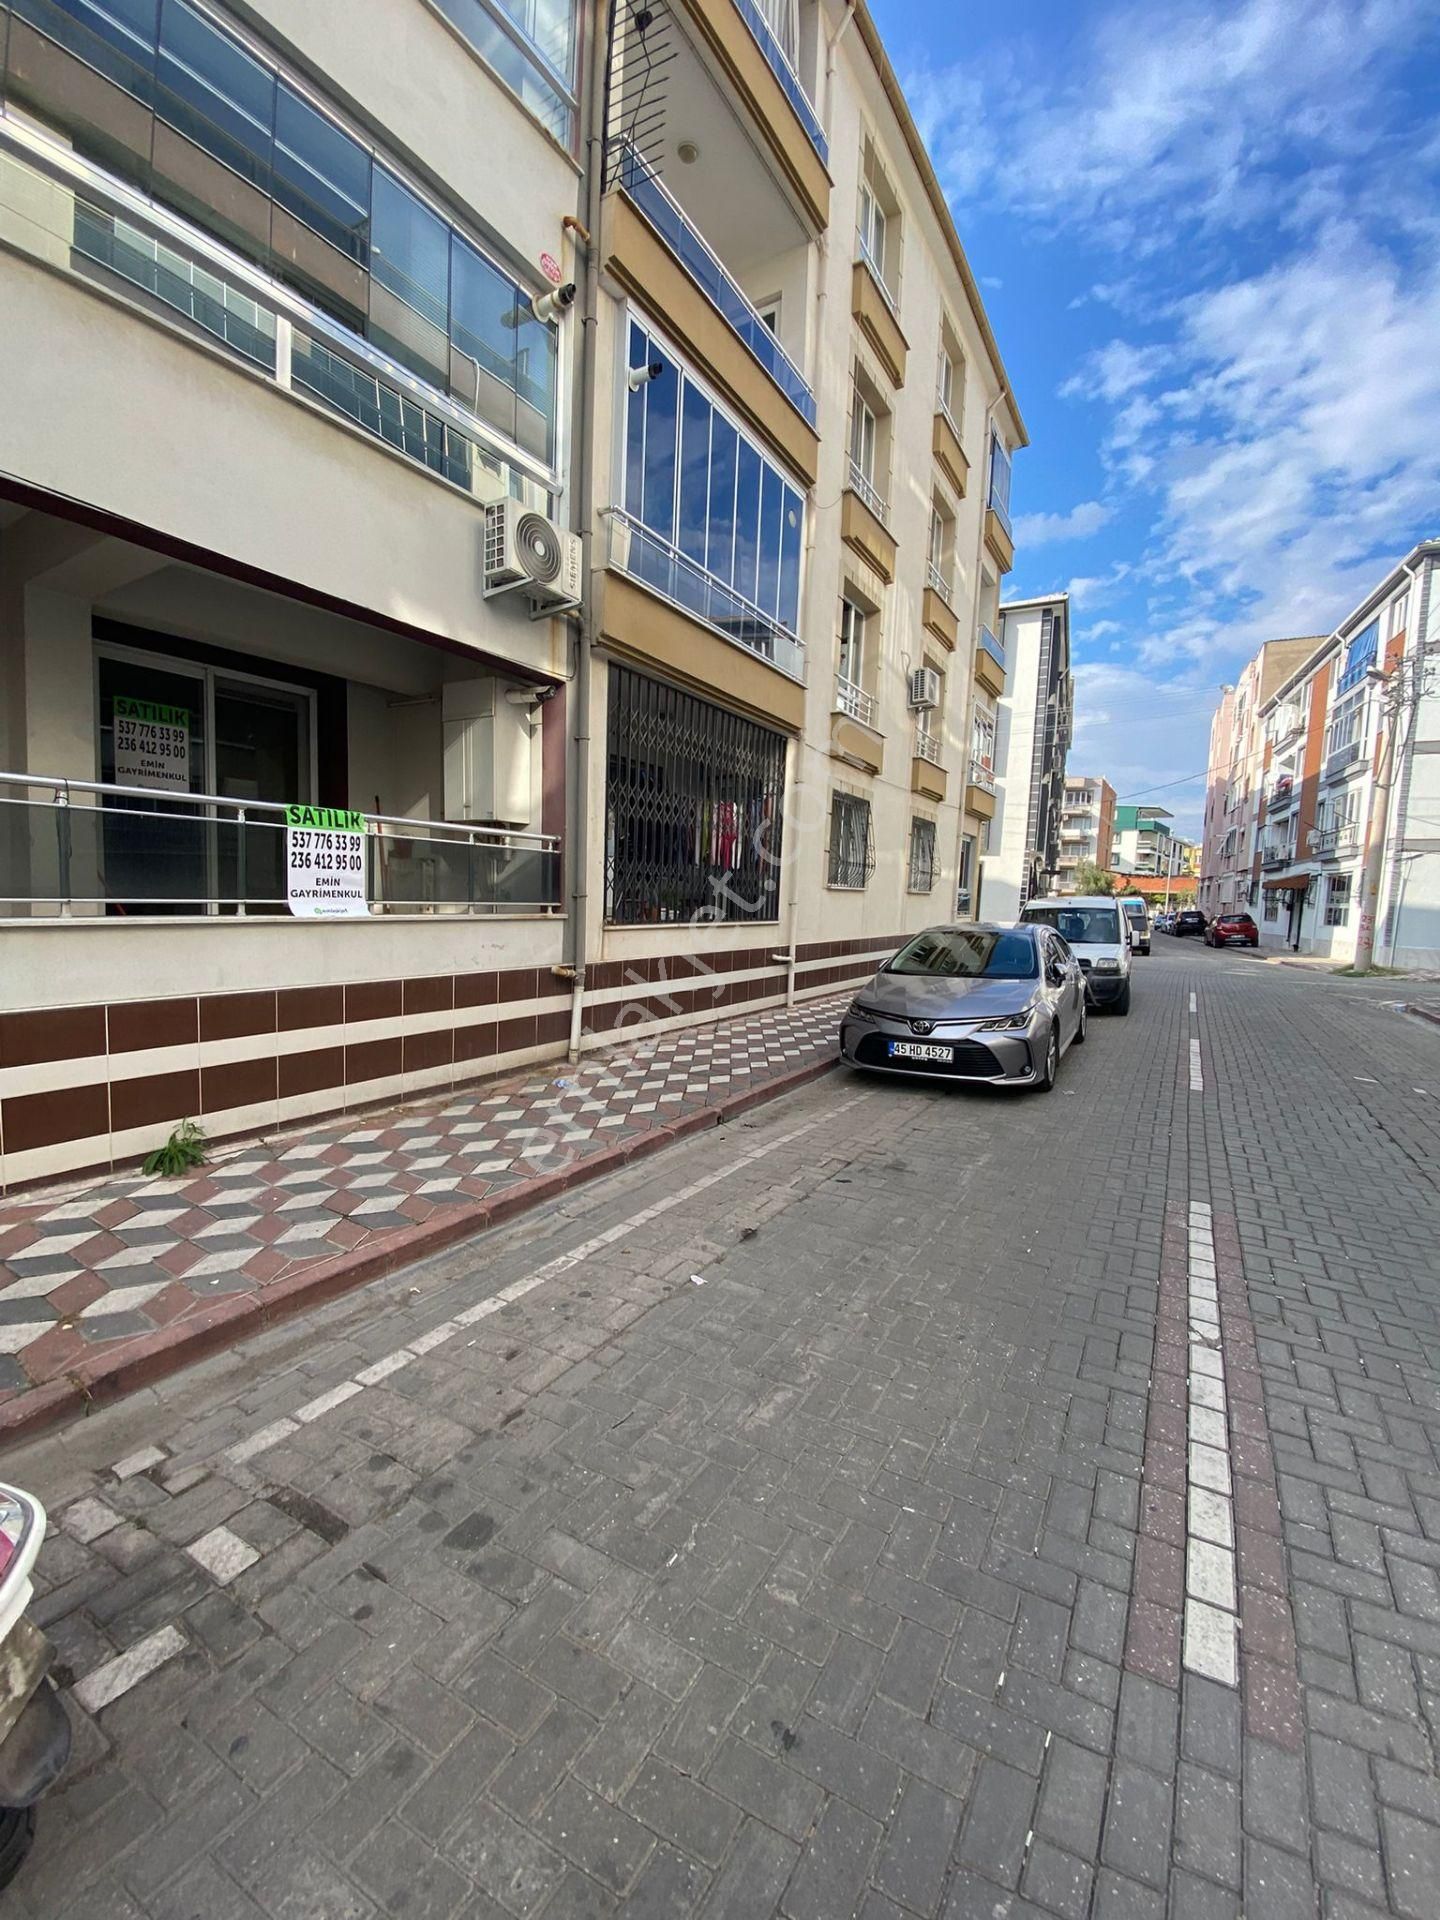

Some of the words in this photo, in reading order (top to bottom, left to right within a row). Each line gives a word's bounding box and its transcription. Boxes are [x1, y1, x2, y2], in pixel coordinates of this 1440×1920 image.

[569, 537, 578, 590] SIEMENS
[117, 700, 186, 727] SATILIK
[118, 720, 137, 735] 537
[139, 723, 157, 738] 776
[160, 727, 171, 741] 33
[173, 730, 185, 743] 99
[118, 737, 137, 751] 236
[139, 740, 157, 755] 412
[160, 743, 171, 757] 95
[173, 745, 186, 759] 00
[140, 759, 165, 769] EMİN
[117, 766, 187, 782] GAYRİMENKUL
[289, 805, 361, 829] SATILIK
[292, 831, 311, 848] 537
[314, 832, 333, 850] 776
[335, 834, 347, 851] 33
[349, 836, 360, 851] 99
[291, 852, 311, 869] 236
[314, 853, 333, 870] 412
[336, 854, 347, 870] 95
[349, 855, 362, 871] 00
[315, 876, 341, 886] EMİN
[290, 888, 363, 899] GAYRİMENKUL
[894, 1044, 907, 1054] 45
[909, 1045, 922, 1056] HD
[925, 1046, 951, 1059] 4527
